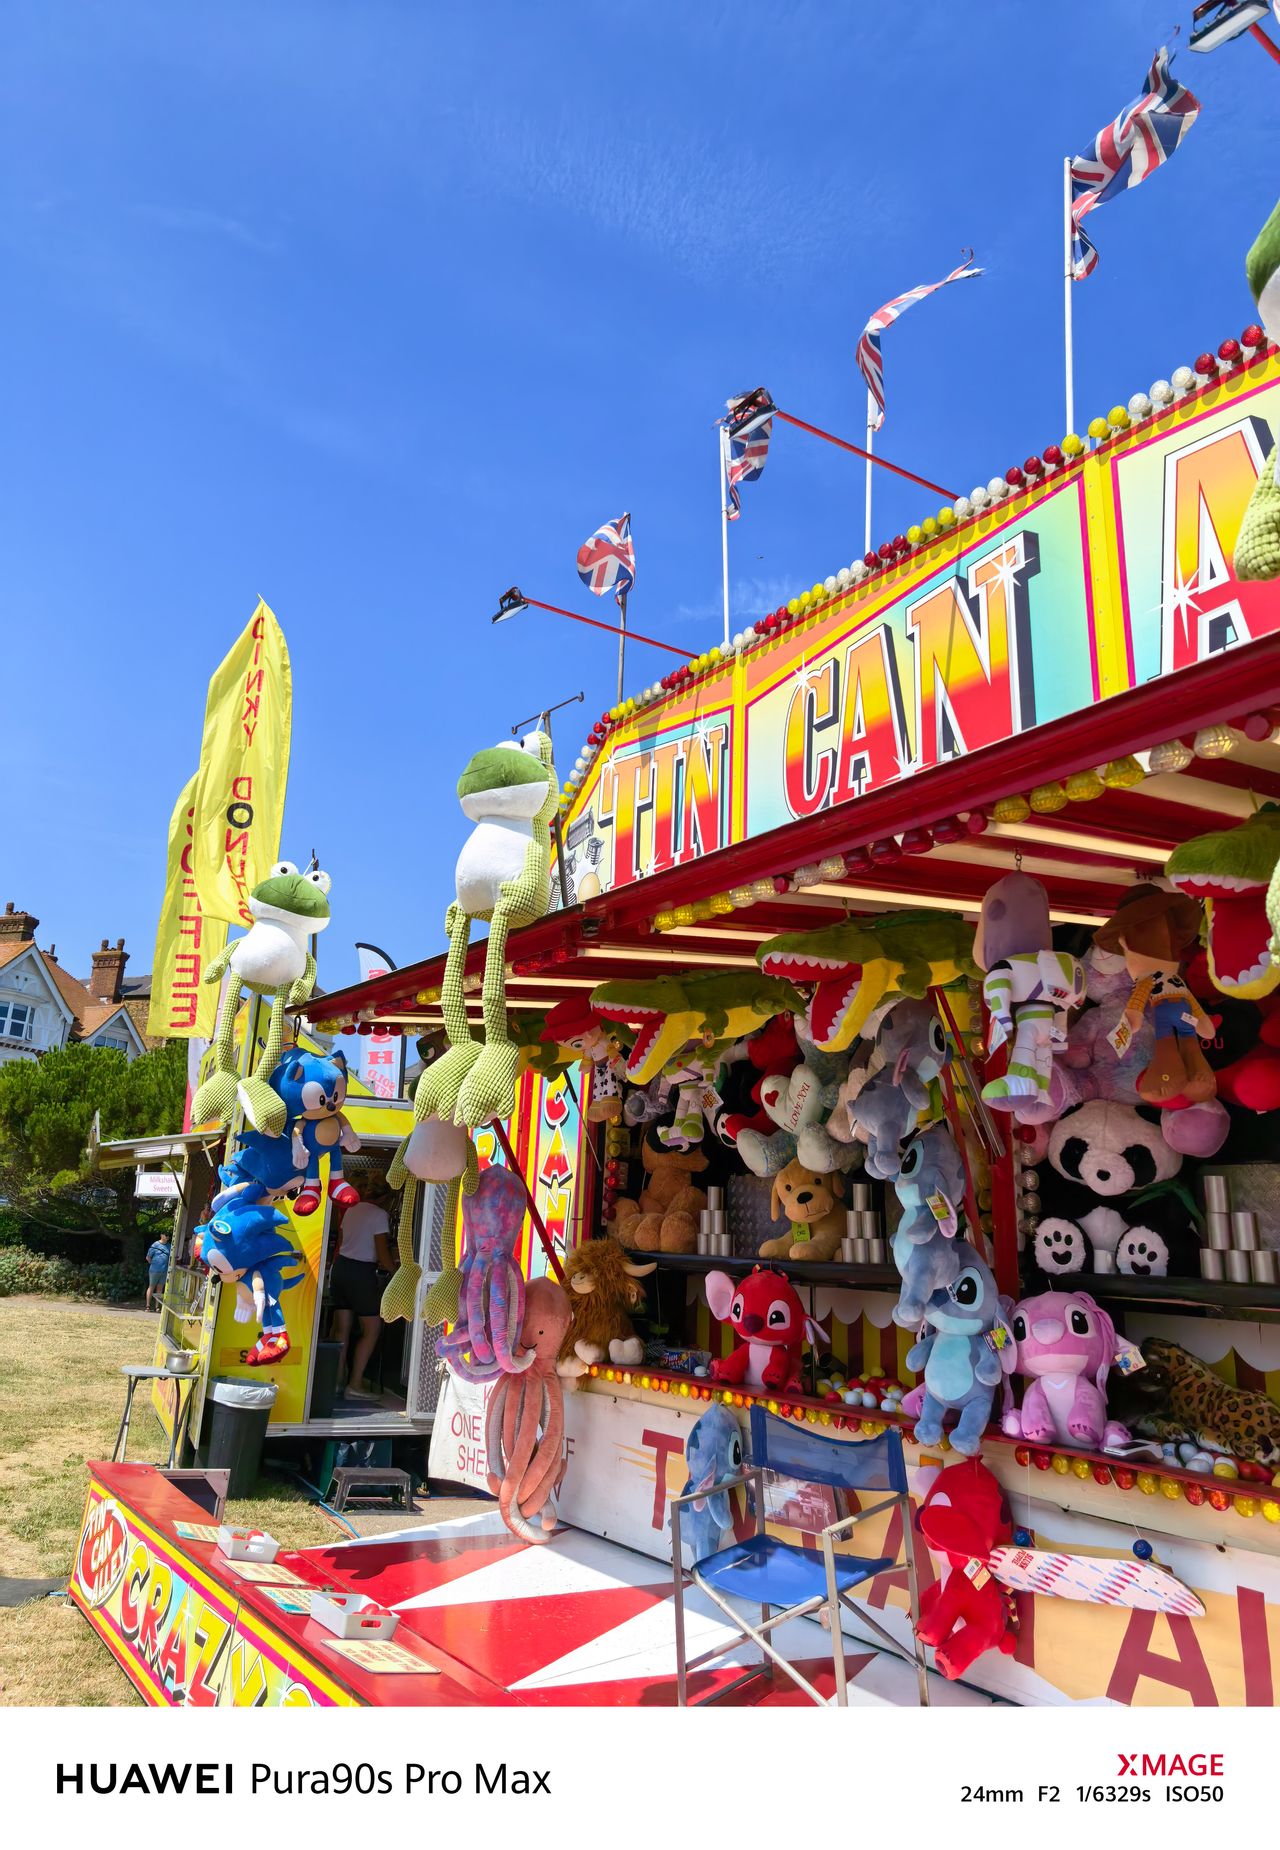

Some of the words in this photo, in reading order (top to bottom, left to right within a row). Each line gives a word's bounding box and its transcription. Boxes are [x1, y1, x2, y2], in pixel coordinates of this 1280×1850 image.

[598, 723, 729, 891] TIN
[783, 530, 1041, 820] CAN
[451, 1411, 482, 1442] ONE
[91, 1520, 114, 1573] CAN
[120, 1540, 268, 1706] CRAZY
